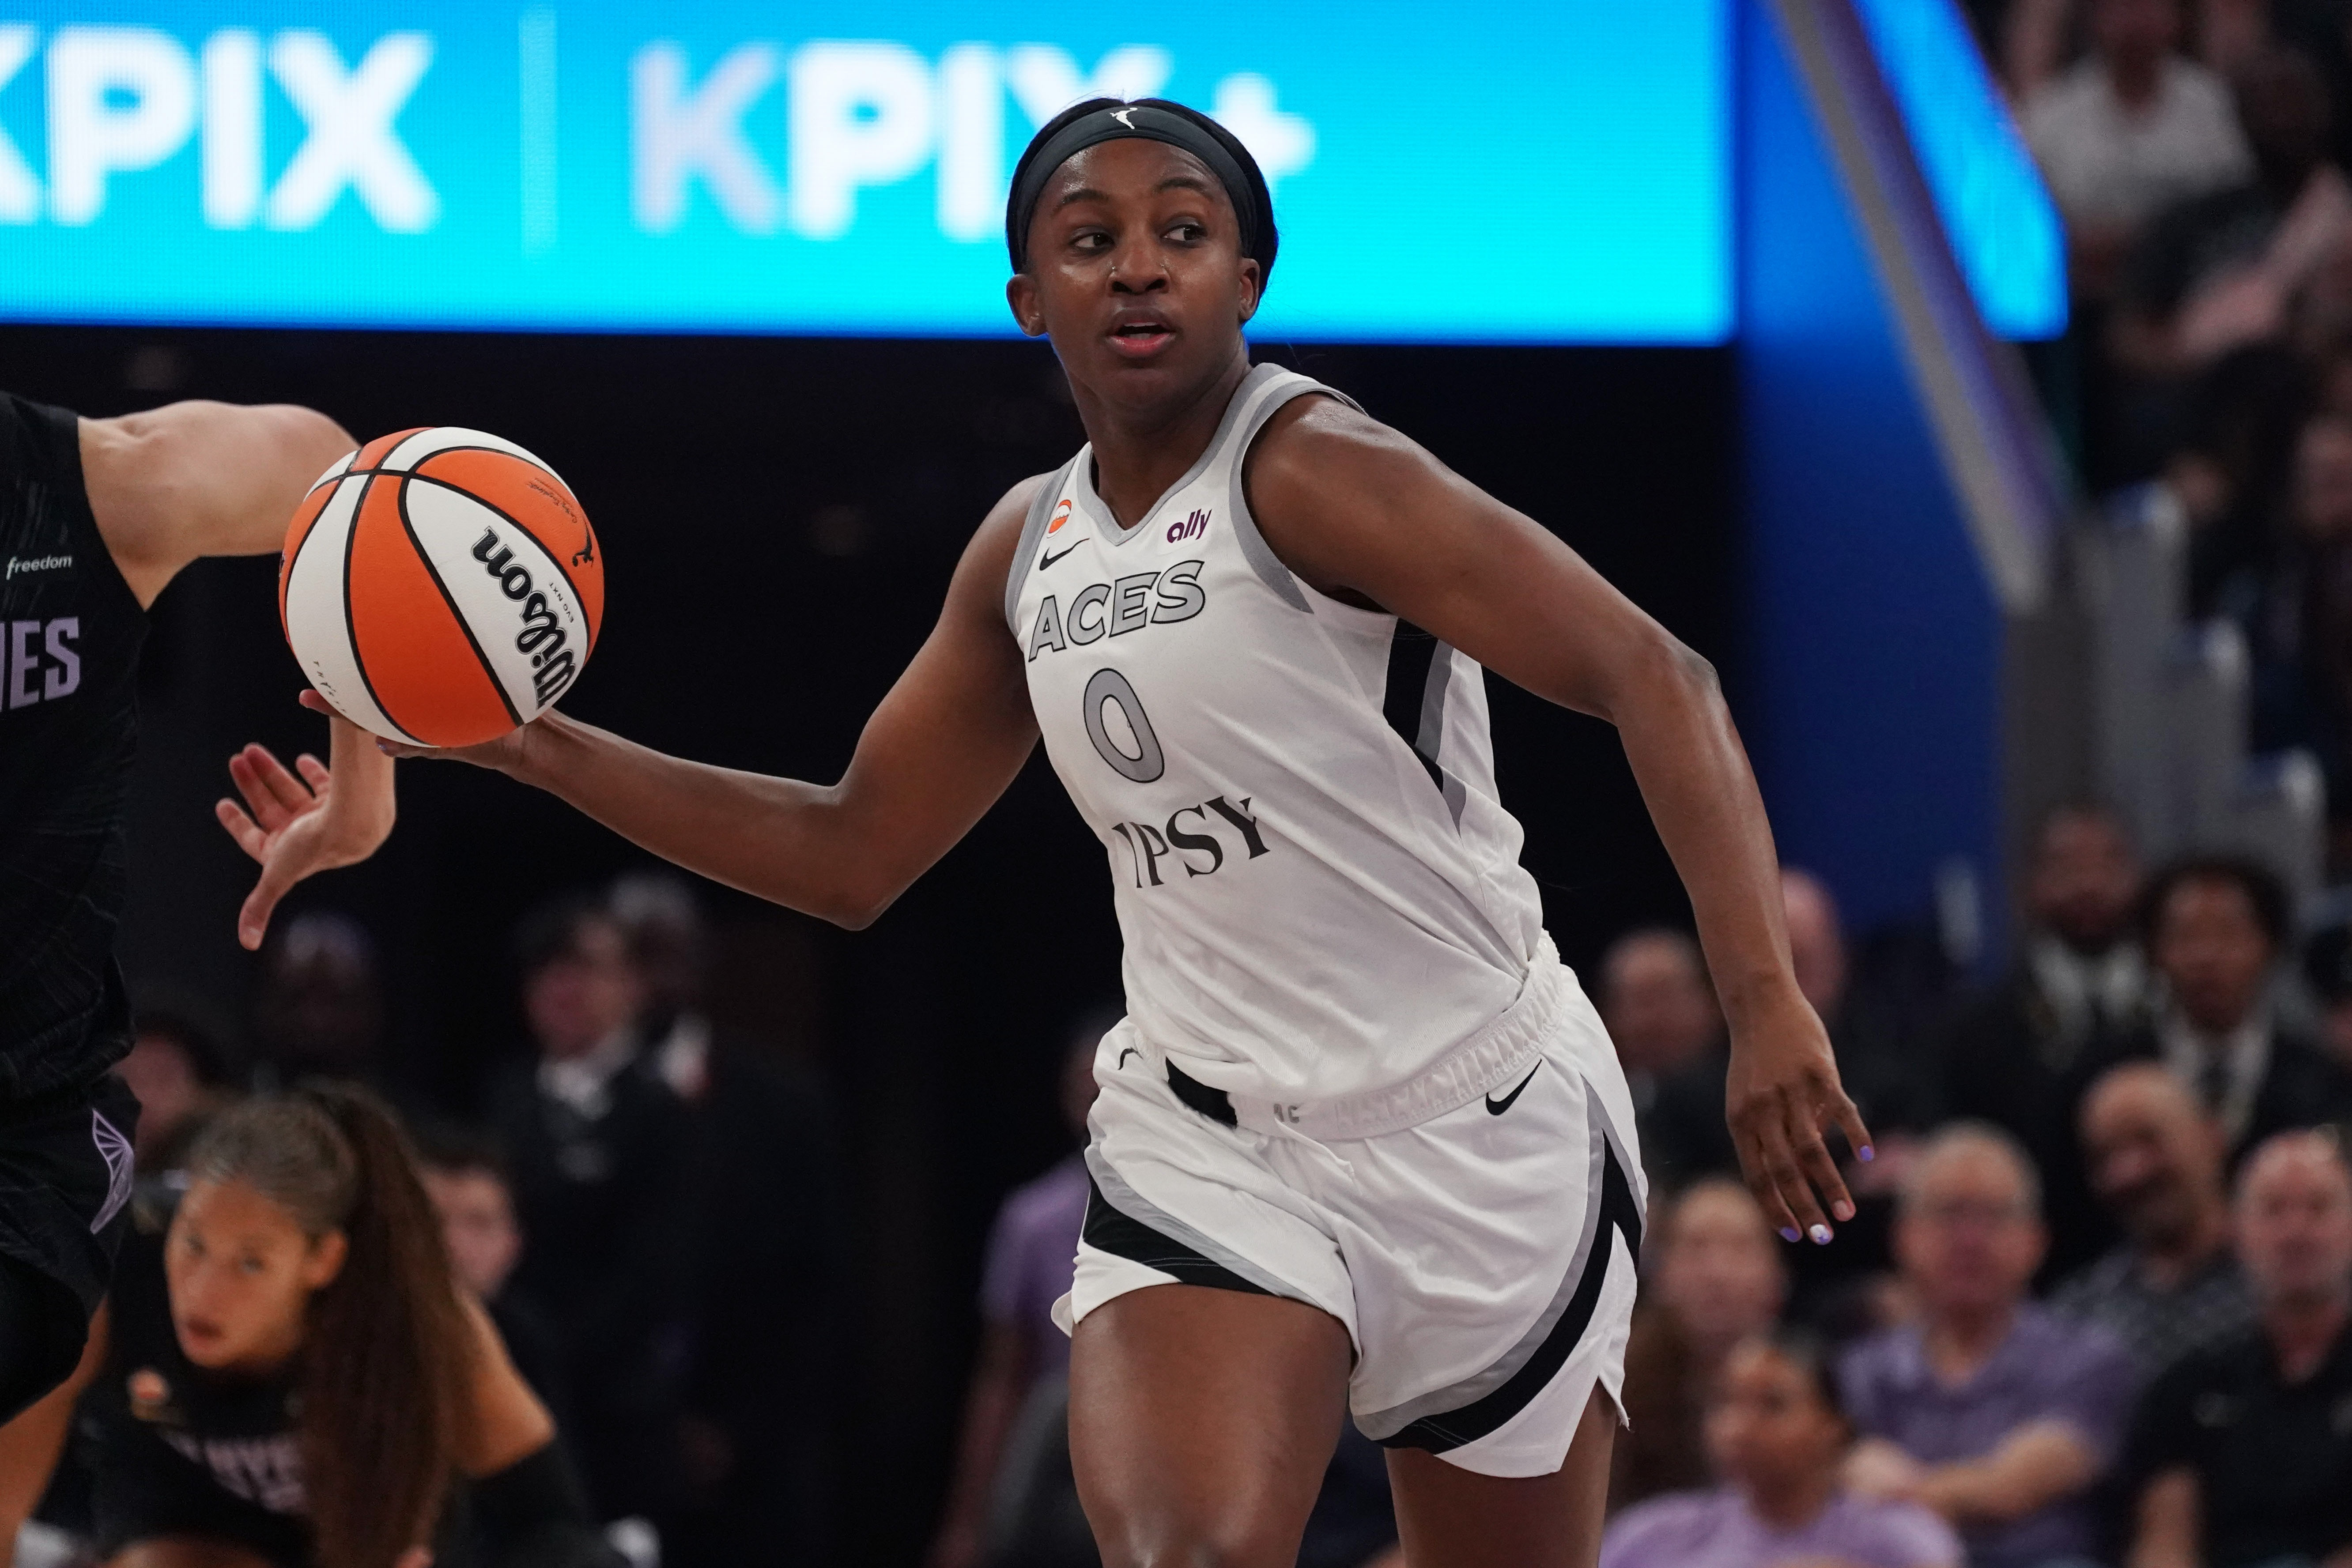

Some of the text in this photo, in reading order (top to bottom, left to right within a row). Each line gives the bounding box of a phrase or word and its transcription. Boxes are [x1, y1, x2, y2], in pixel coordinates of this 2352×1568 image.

[1167, 509, 1212, 543] ally
[6, 554, 72, 580] freedom
[549, 582, 574, 623] EVO NXT
[471, 526, 577, 710] Wilson
[1028, 560, 1205, 662] ACES
[1084, 668, 1165, 783] 0
